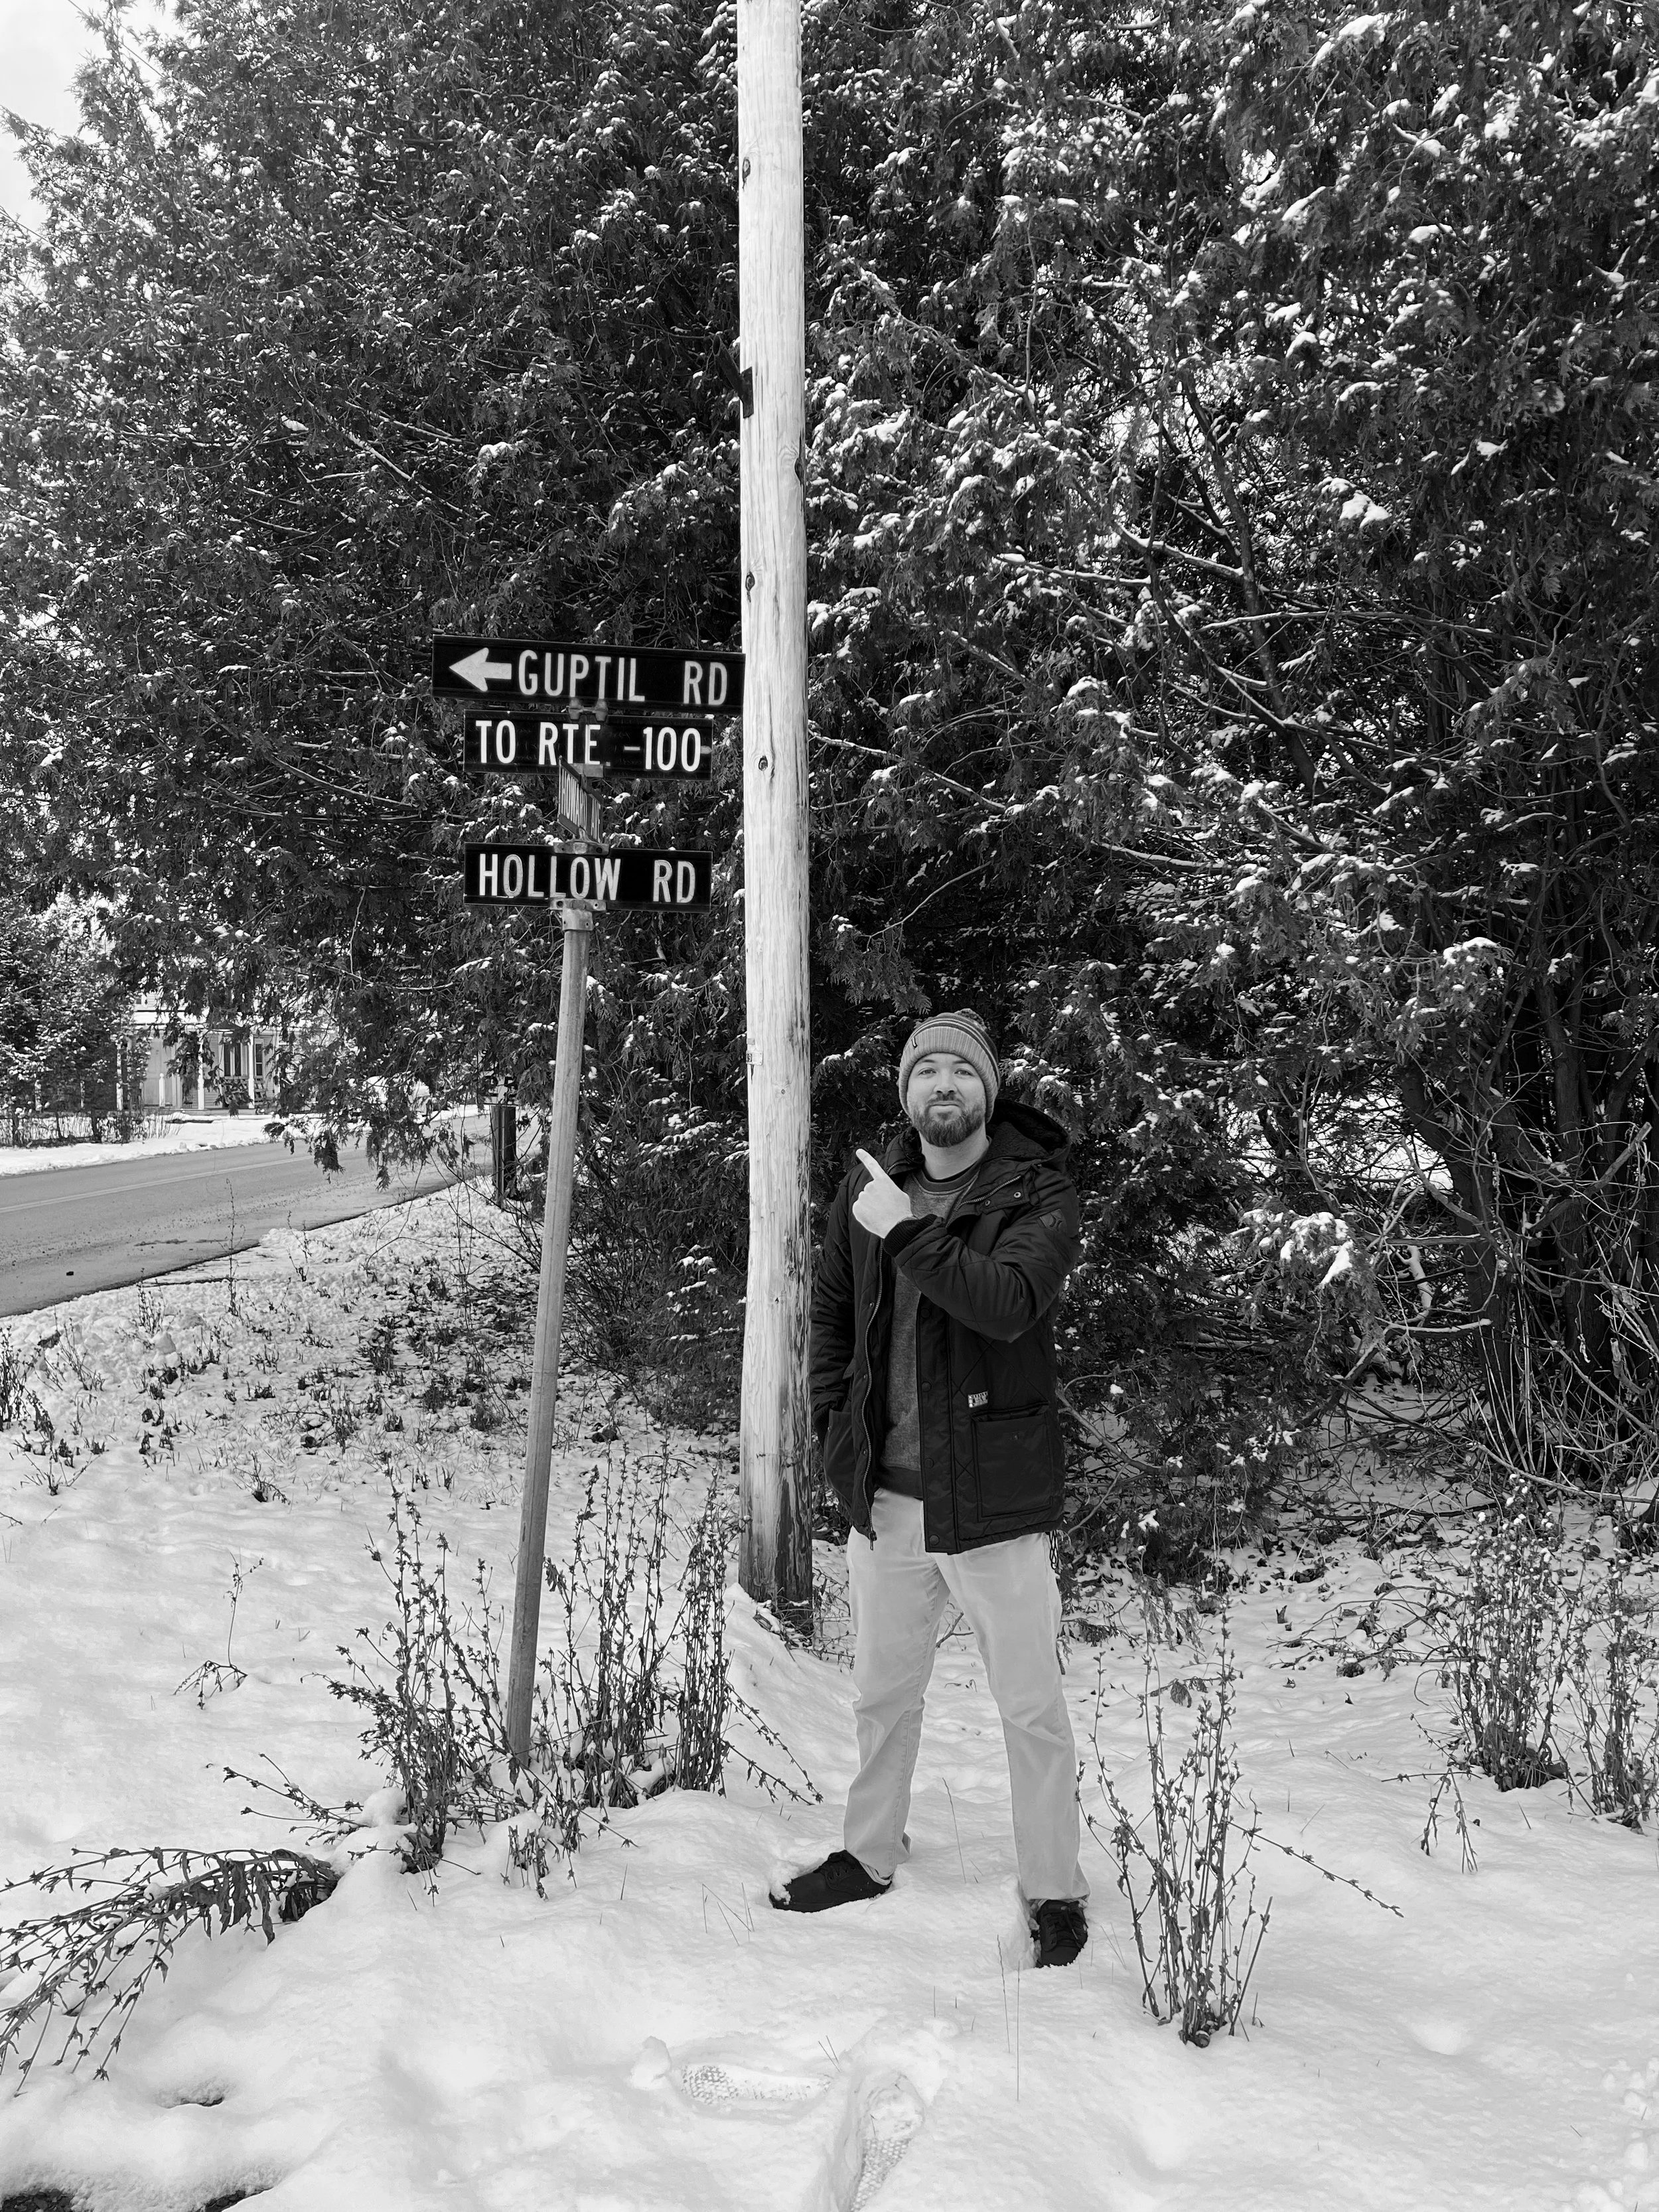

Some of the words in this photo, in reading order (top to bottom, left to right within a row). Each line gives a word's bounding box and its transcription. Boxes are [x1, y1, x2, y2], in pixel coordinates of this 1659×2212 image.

[518, 650, 645, 702] GUPTIL
[684, 660, 727, 705] RD
[475, 720, 516, 764] TO
[479, 853, 621, 901] HOLLOW
[653, 859, 696, 903] RD
